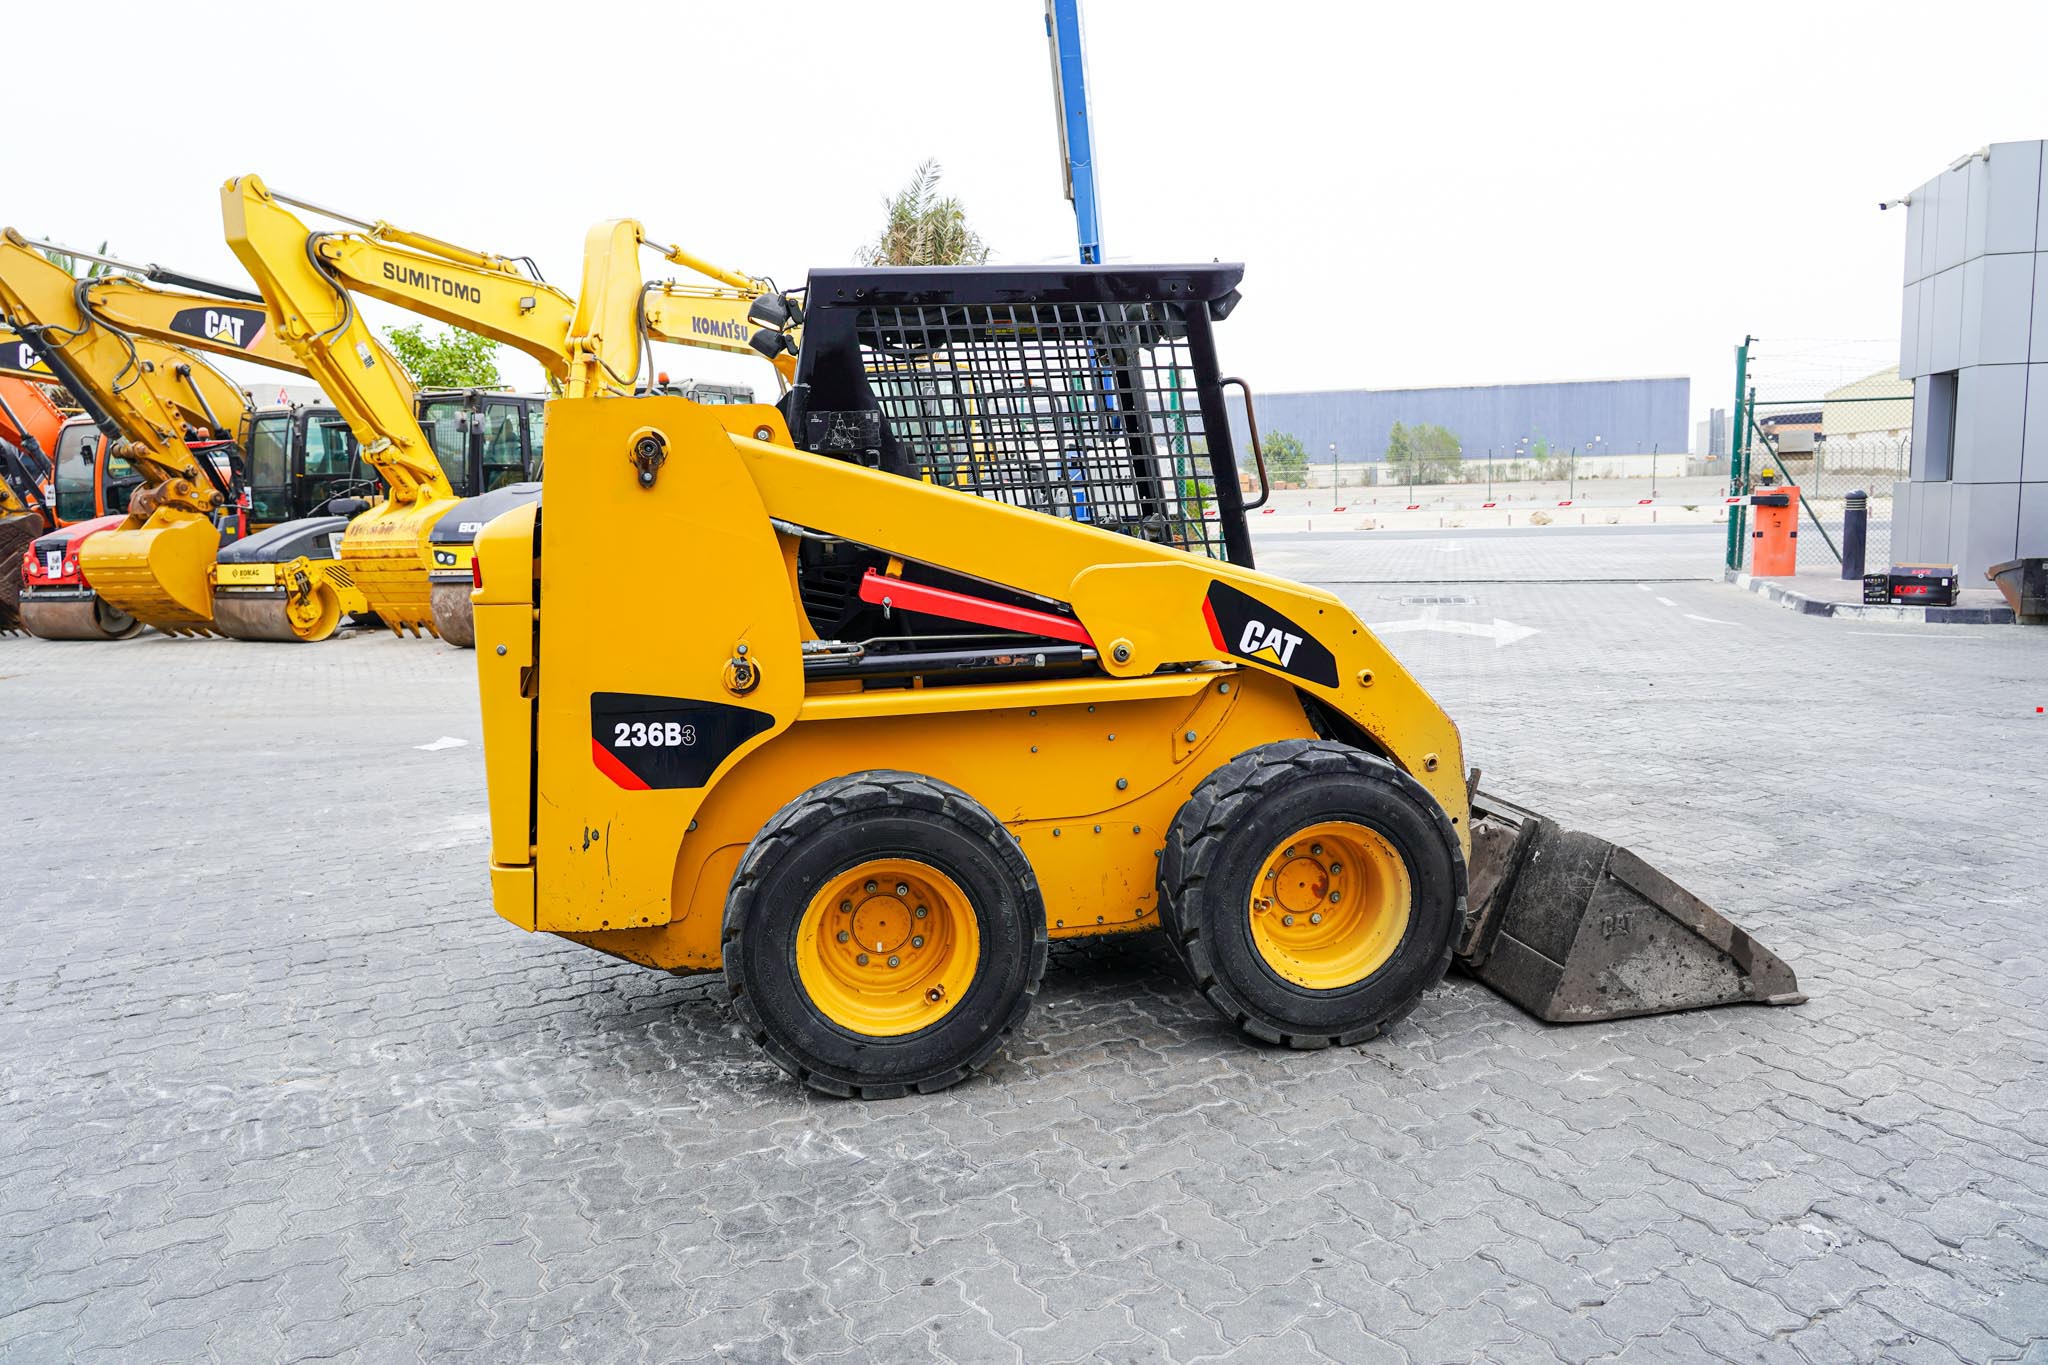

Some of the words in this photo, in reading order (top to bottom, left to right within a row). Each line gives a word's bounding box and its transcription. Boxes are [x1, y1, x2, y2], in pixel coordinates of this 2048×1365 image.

[383, 261, 481, 304] SUMITOMO
[204, 310, 245, 346] CAT
[692, 316, 749, 342] KOMATSU
[1239, 620, 1304, 668] CAT
[614, 722, 697, 747] 236B3
[1602, 913, 1635, 937] CAT
